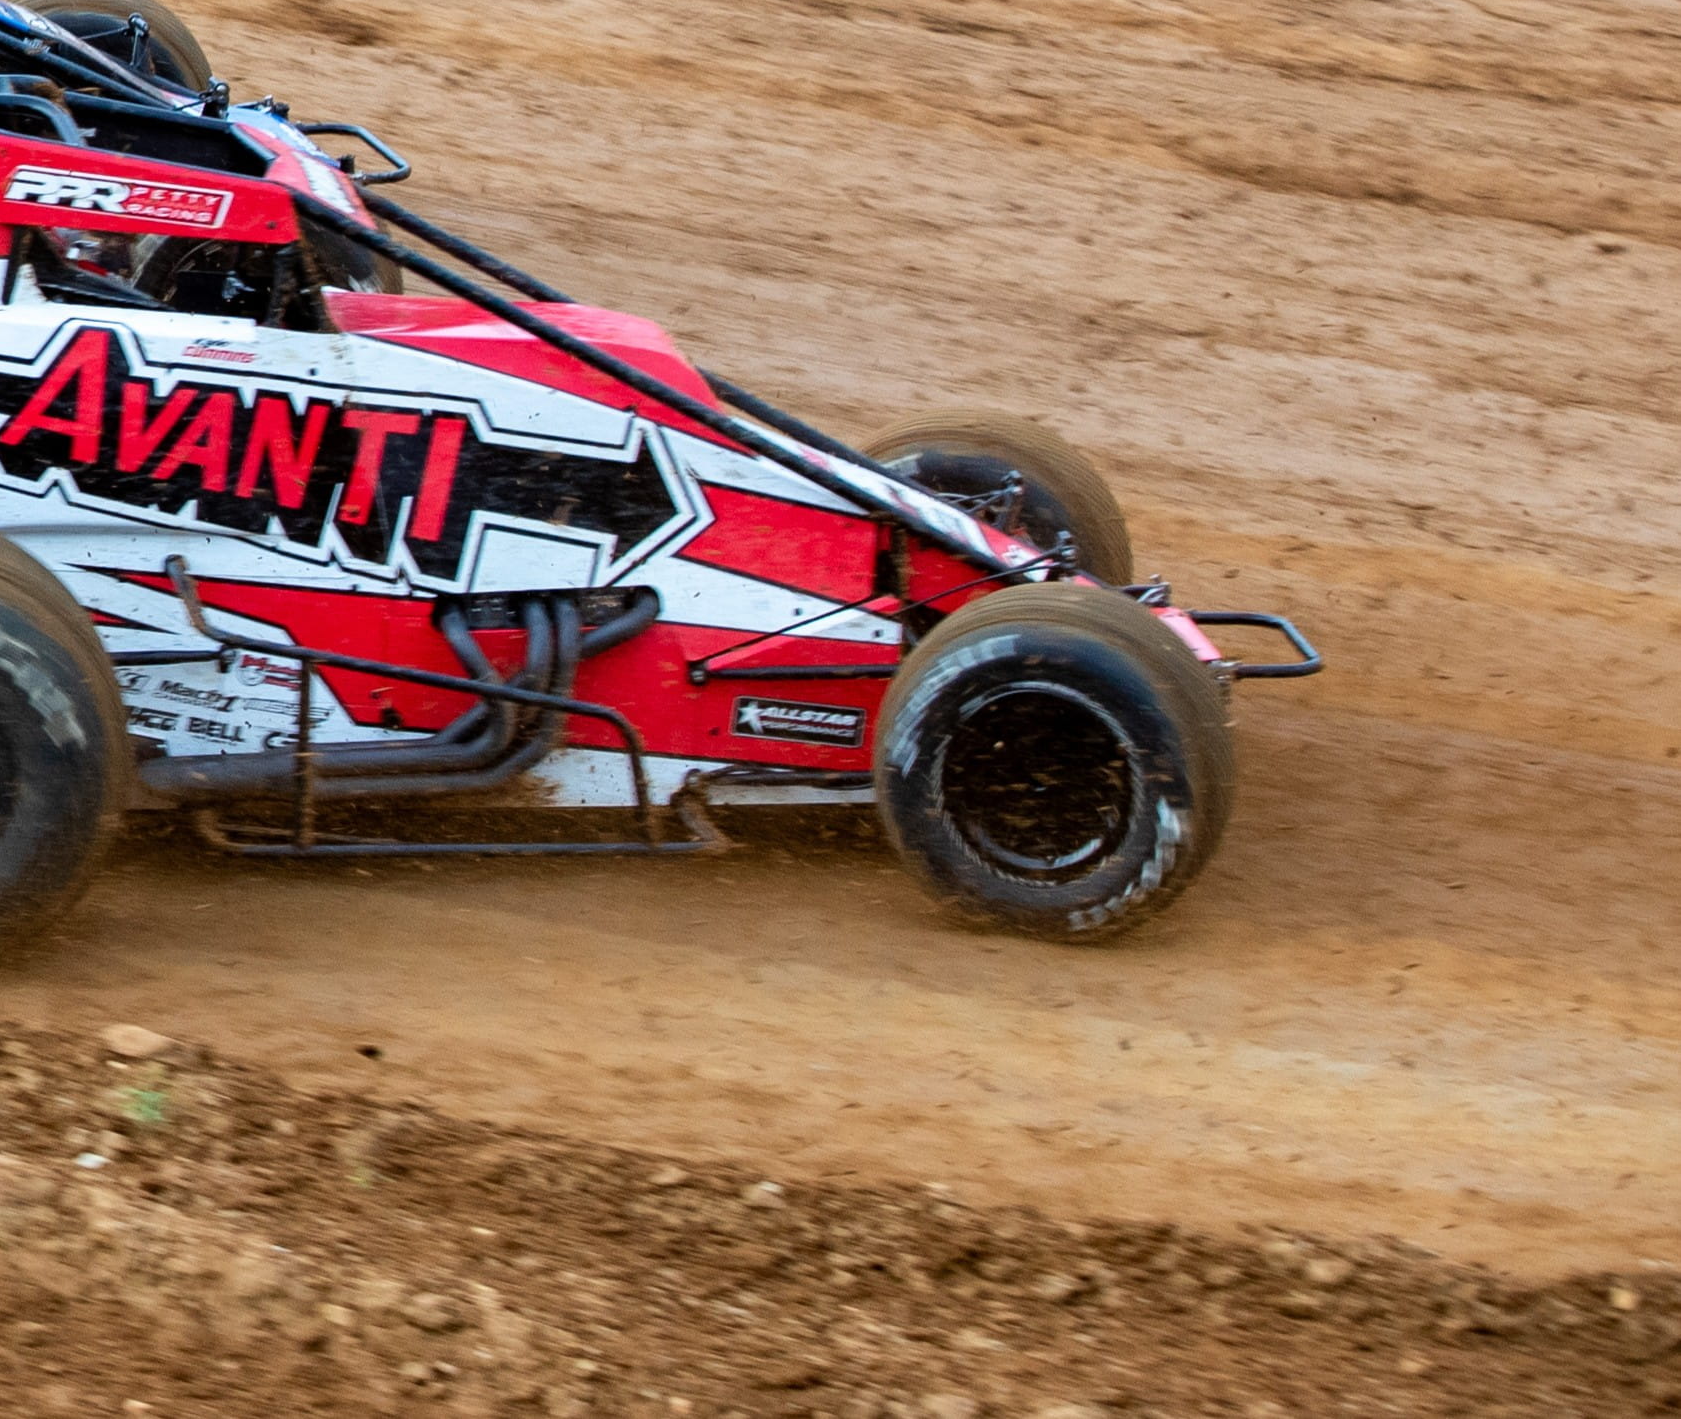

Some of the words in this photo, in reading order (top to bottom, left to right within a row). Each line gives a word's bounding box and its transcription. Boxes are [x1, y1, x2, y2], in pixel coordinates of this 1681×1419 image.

[4, 169, 130, 214] PPR
[130, 186, 221, 207] PETTY
[125, 202, 213, 223] RACING
[0, 328, 466, 544] AVANTI
[759, 706, 858, 726] ALLSTAR
